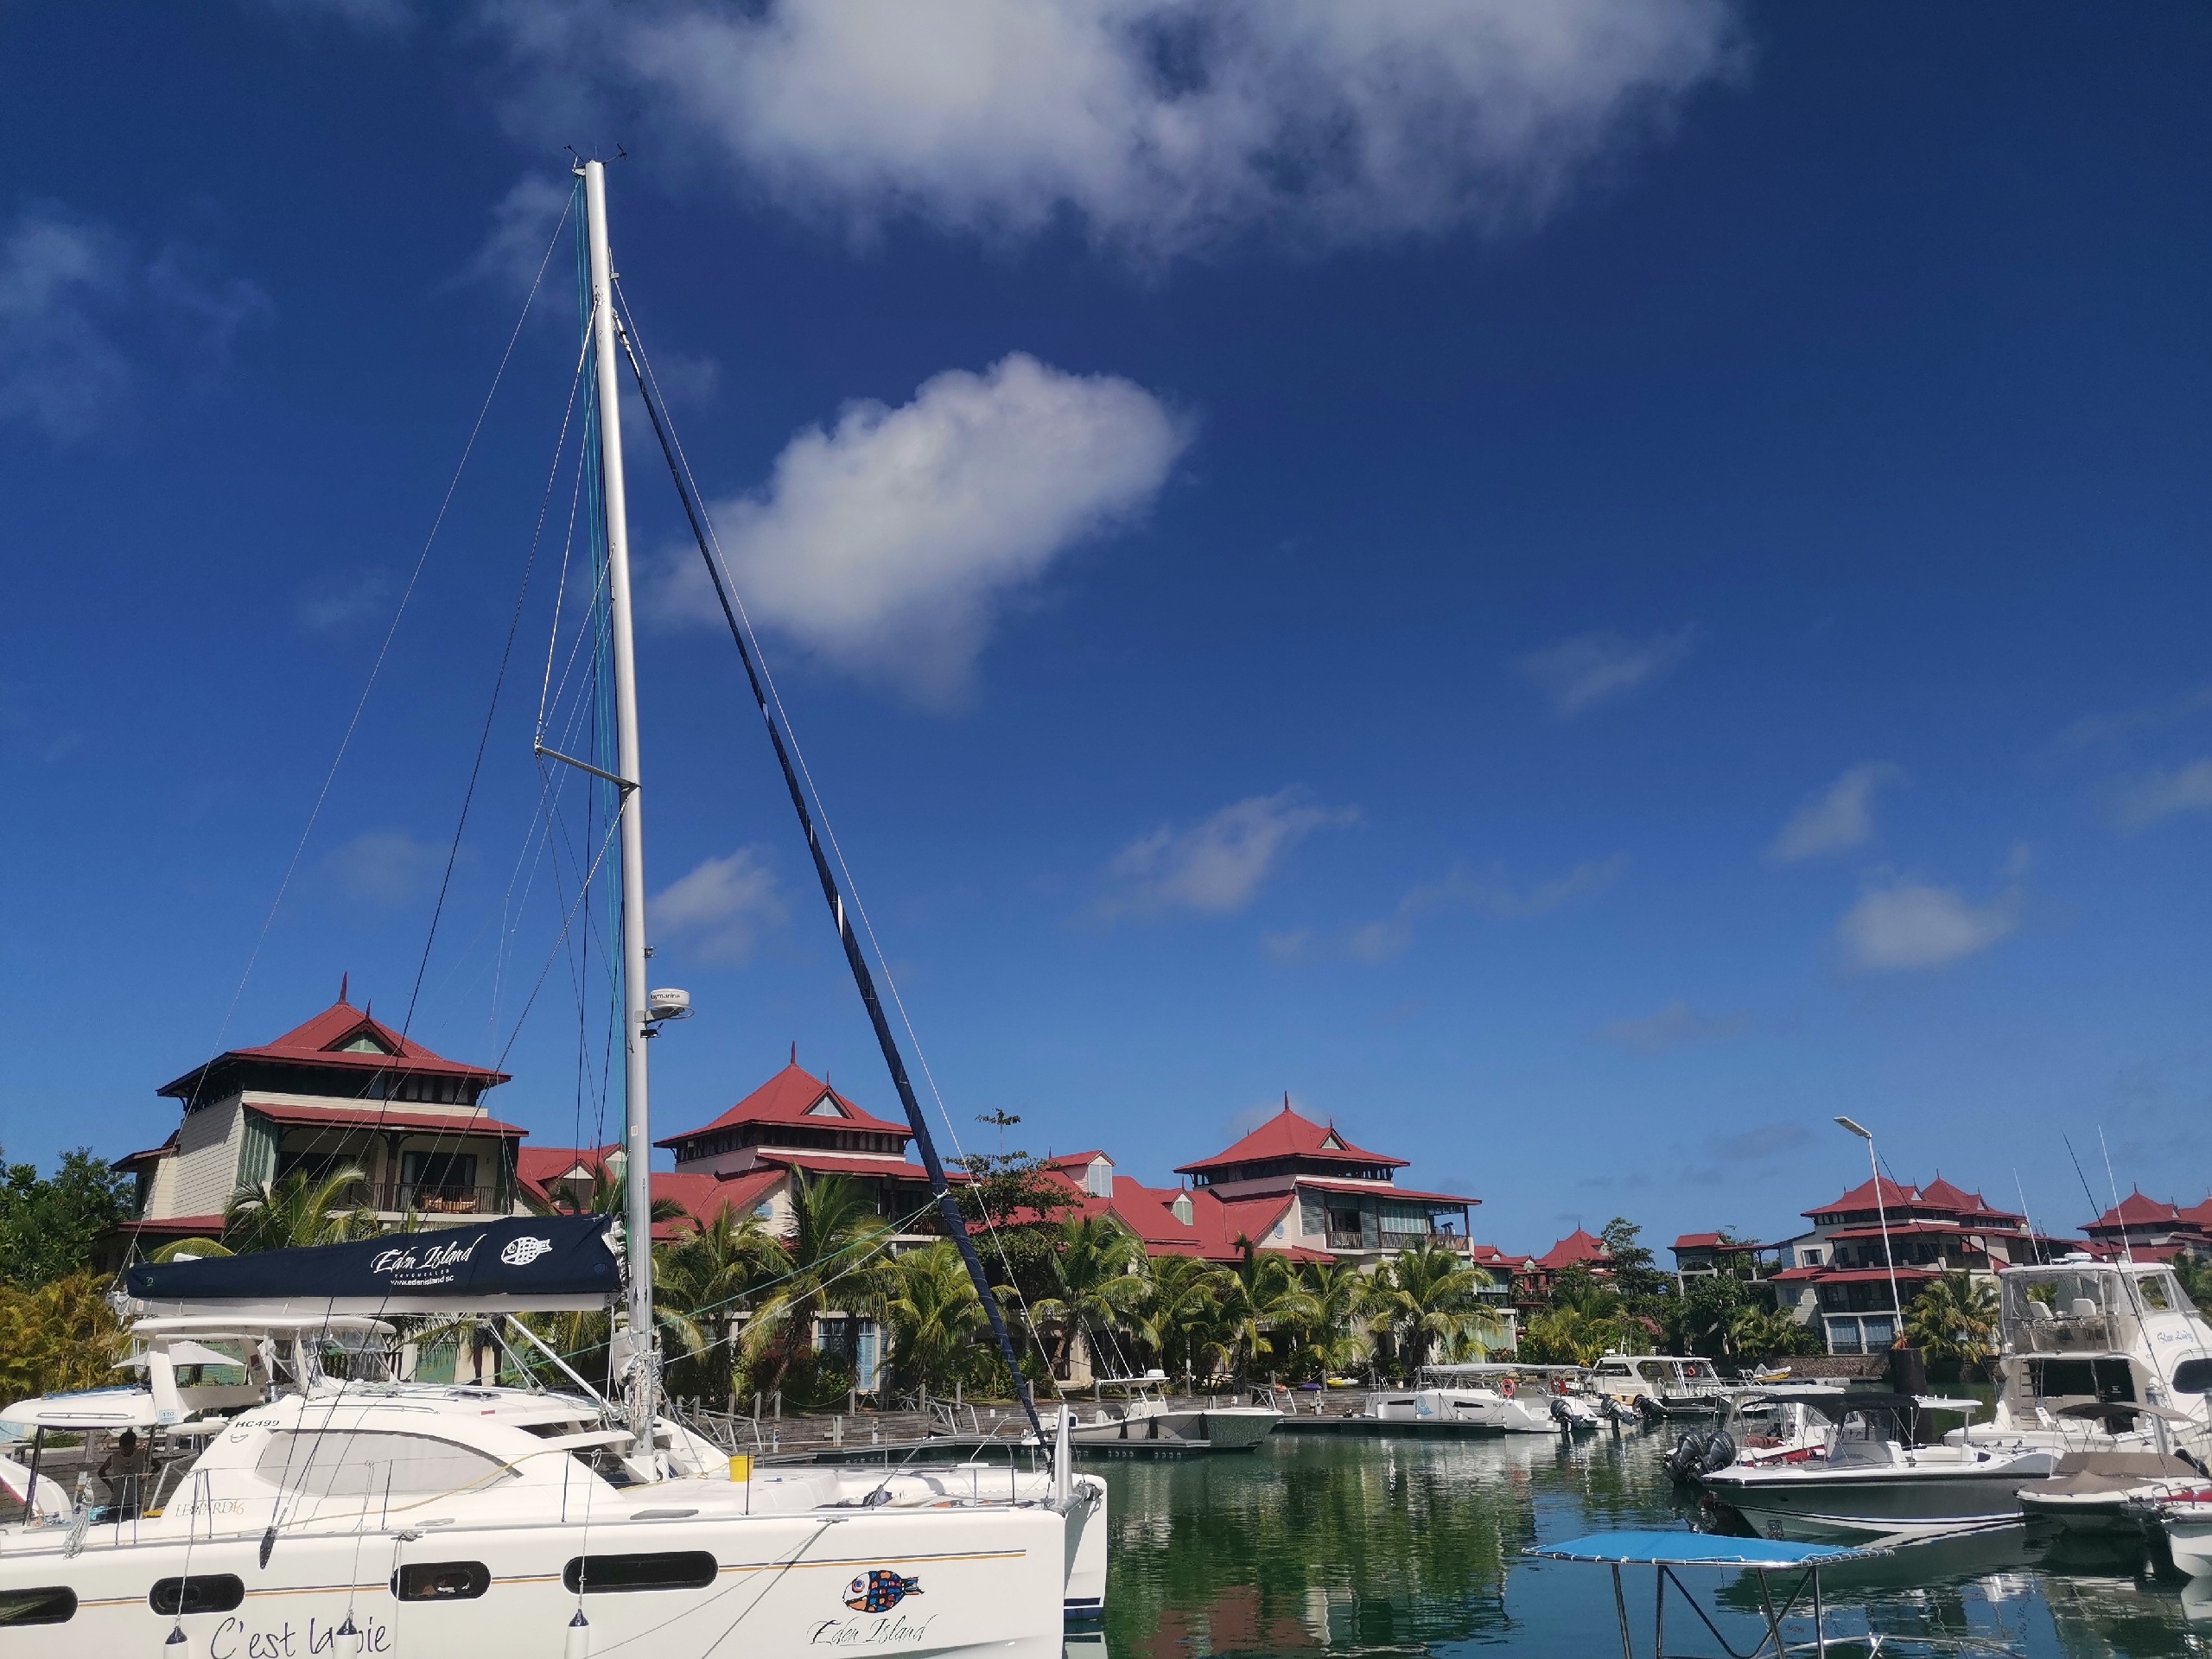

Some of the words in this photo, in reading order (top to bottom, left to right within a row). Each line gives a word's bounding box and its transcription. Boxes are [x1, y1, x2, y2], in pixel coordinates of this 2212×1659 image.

[370, 1246, 419, 1274] Eden
[415, 1233, 488, 1269] Island
[390, 1274, 454, 1286] www.edenislandsc
[234, 1420, 280, 1428] HC499
[210, 1617, 296, 1659] C'est
[806, 1617, 861, 1646] Eden
[864, 1613, 939, 1645] Island
